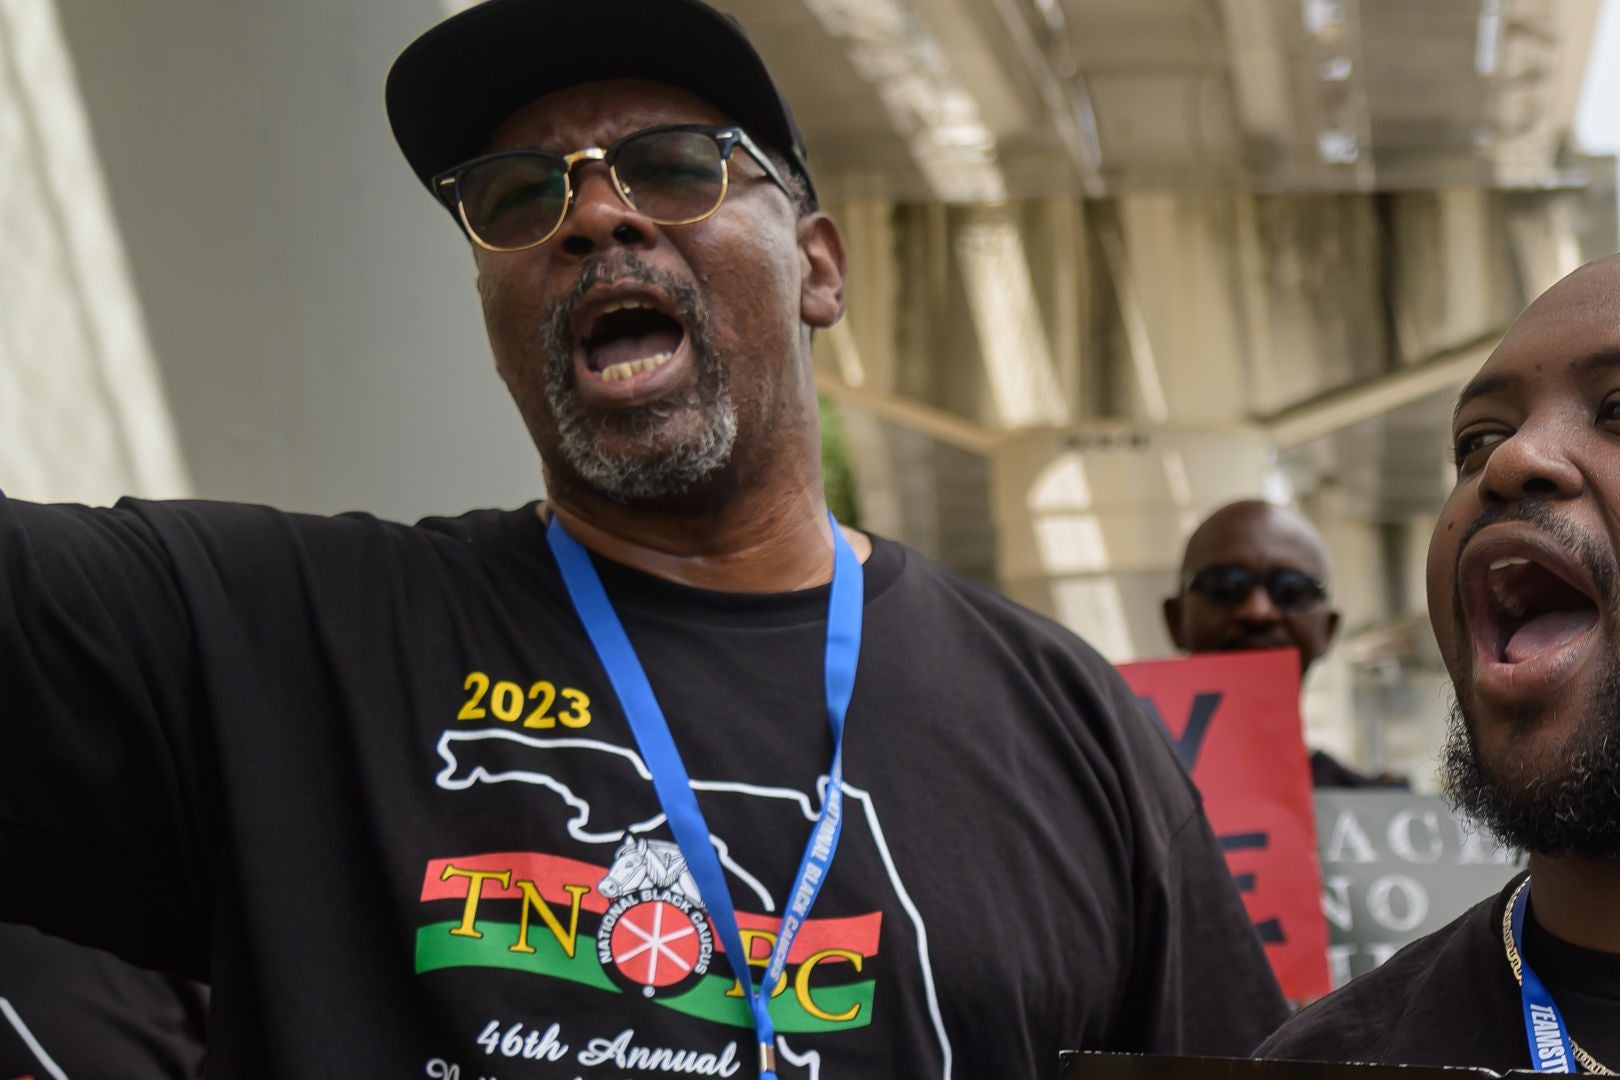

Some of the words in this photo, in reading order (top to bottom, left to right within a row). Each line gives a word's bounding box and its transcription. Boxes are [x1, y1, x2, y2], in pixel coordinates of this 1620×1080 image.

[456, 671, 593, 729] 2023
[440, 863, 590, 959] TN
[791, 862, 823, 917] BLACK
[597, 893, 640, 964] NATIONAL
[640, 888, 693, 914] BLACK
[690, 910, 713, 975] CAUCUS
[770, 915, 799, 982] CAUCUS
[476, 1020, 569, 1062] 46th
[577, 1029, 741, 1078] Annual
[1529, 1003, 1570, 1074] TEAMST
